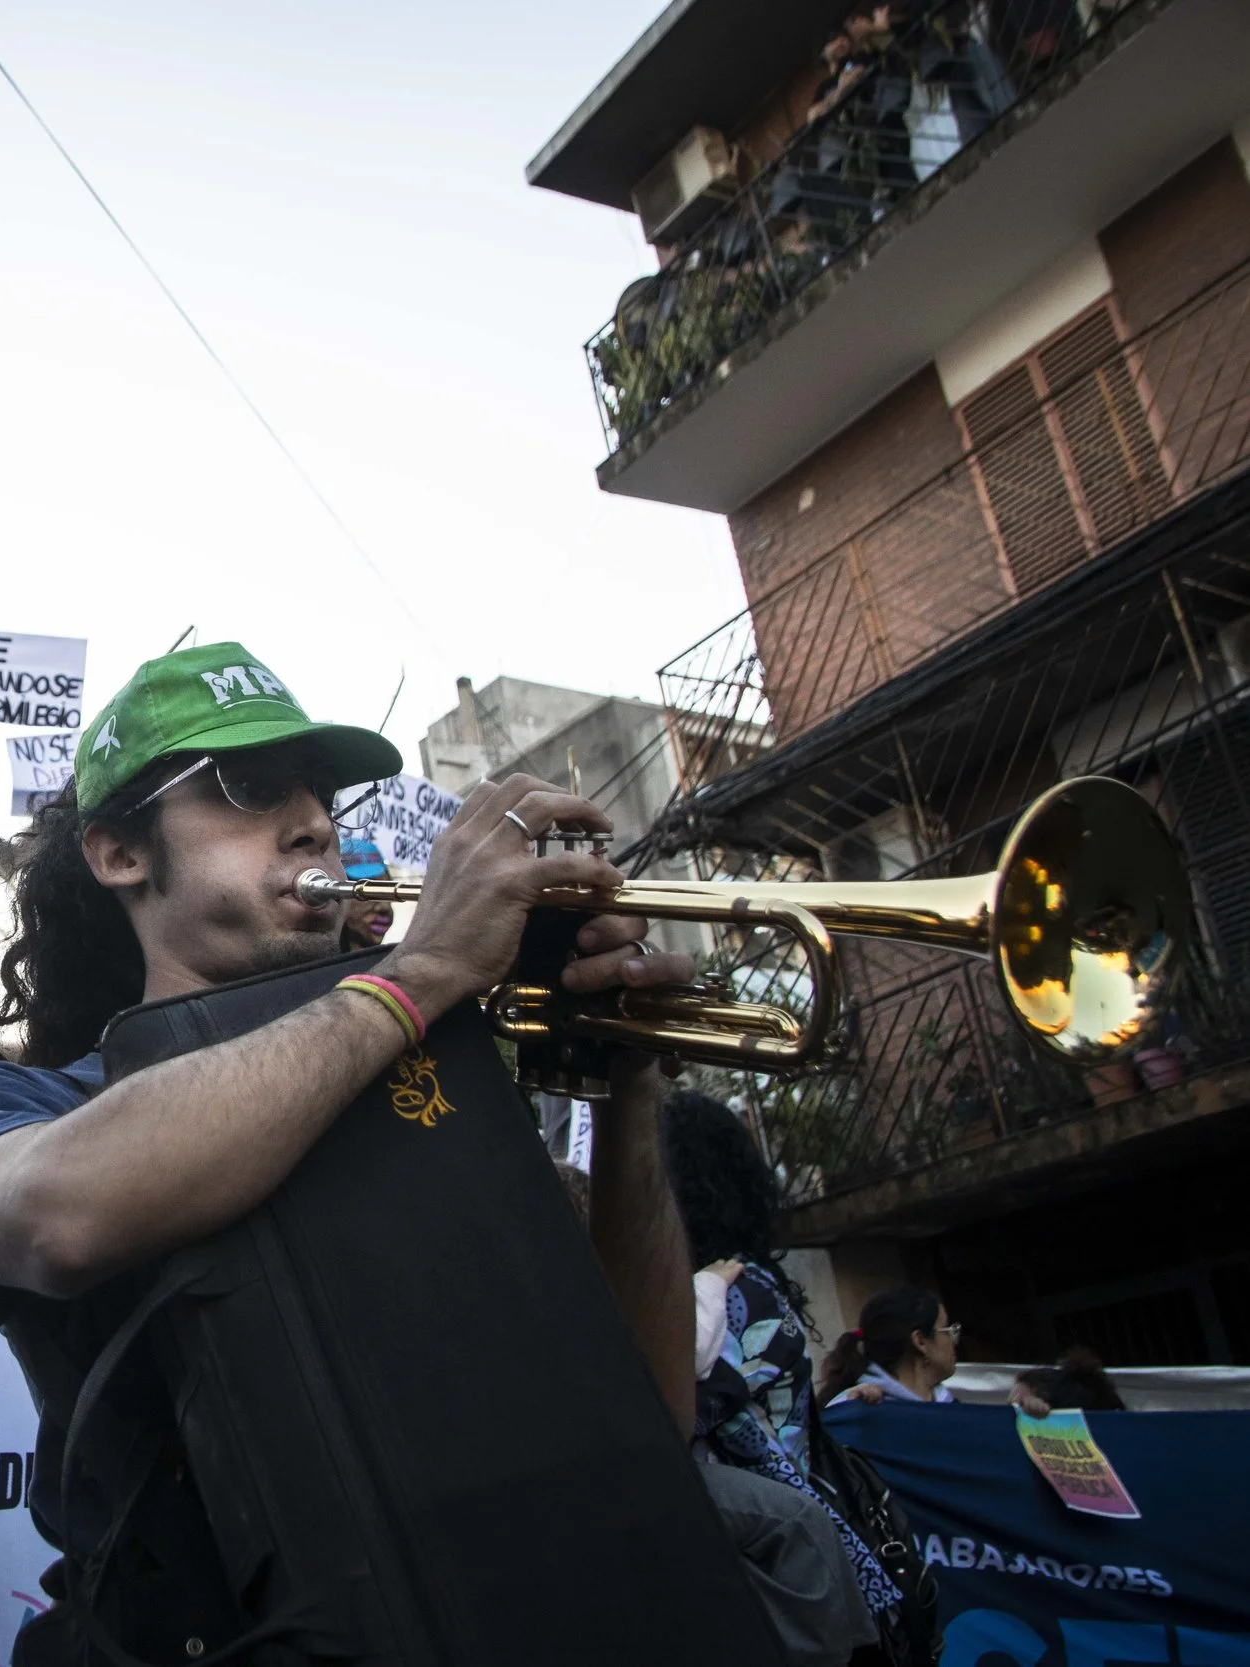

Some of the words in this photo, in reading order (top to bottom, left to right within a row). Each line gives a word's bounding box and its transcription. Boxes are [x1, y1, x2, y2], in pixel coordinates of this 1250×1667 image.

[13, 736, 45, 764] NO
[49, 734, 74, 762] SE
[913, 1533, 1173, 1597] ABAJADORES
